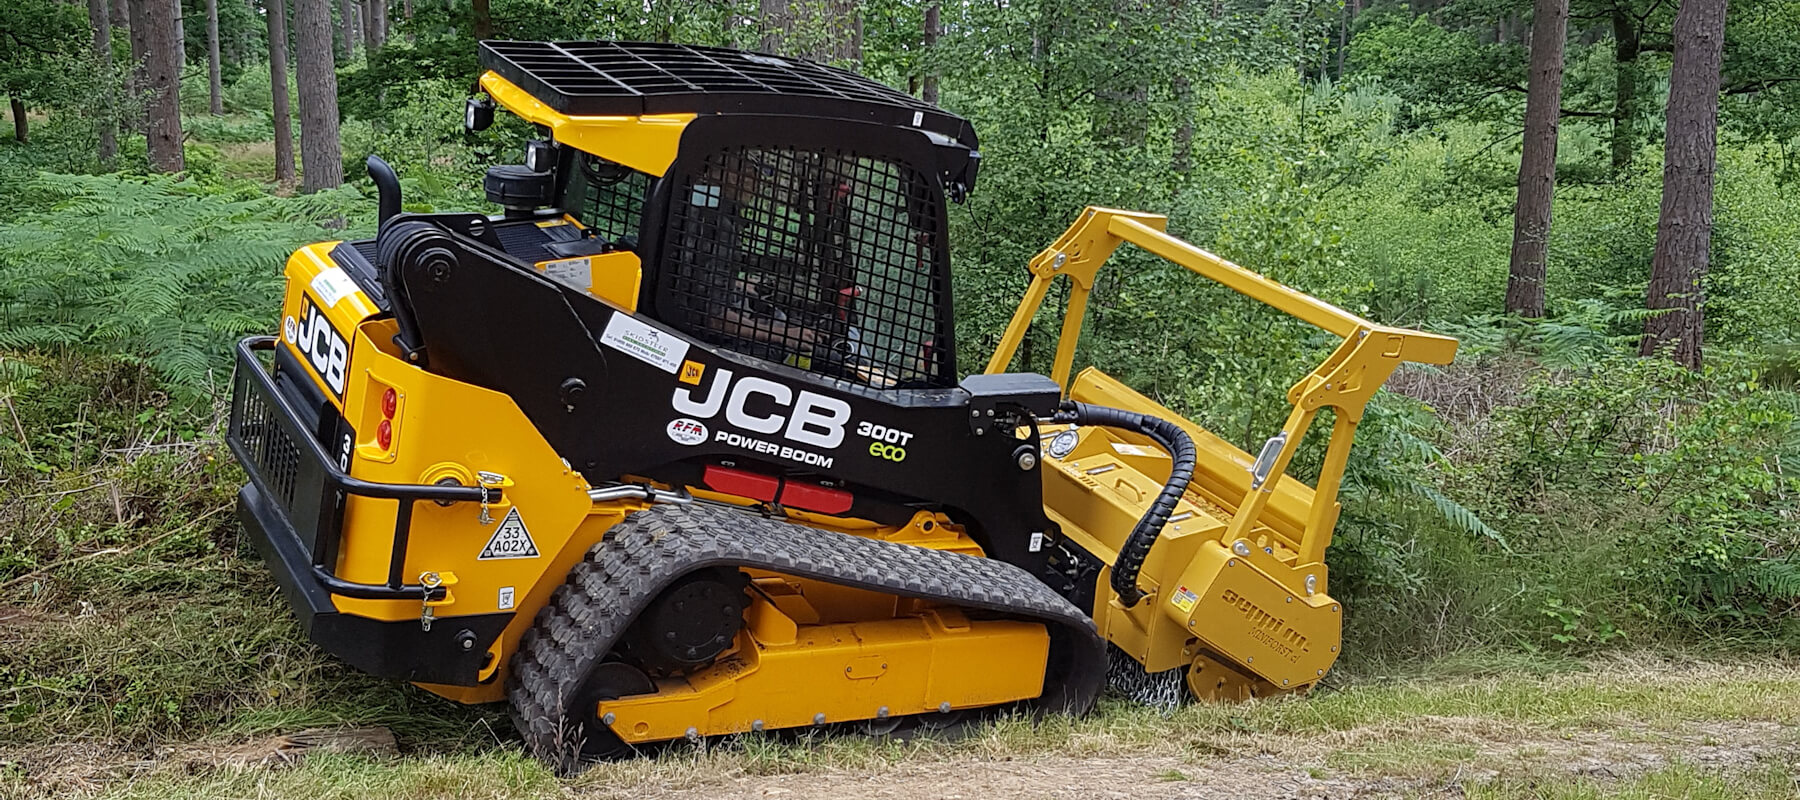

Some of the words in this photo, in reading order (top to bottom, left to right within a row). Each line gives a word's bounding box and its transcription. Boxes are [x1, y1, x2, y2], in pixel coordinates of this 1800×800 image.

[299, 305, 347, 395] JCB
[672, 368, 852, 449] JCB
[673, 420, 703, 436] RFM
[857, 421, 914, 446] 300T
[715, 430, 780, 456] POWER
[780, 446, 834, 469] BOOM
[869, 441, 907, 462] eco
[503, 527, 520, 539] 33
[494, 540, 528, 552] A02X
[1221, 588, 1285, 633] seppi
